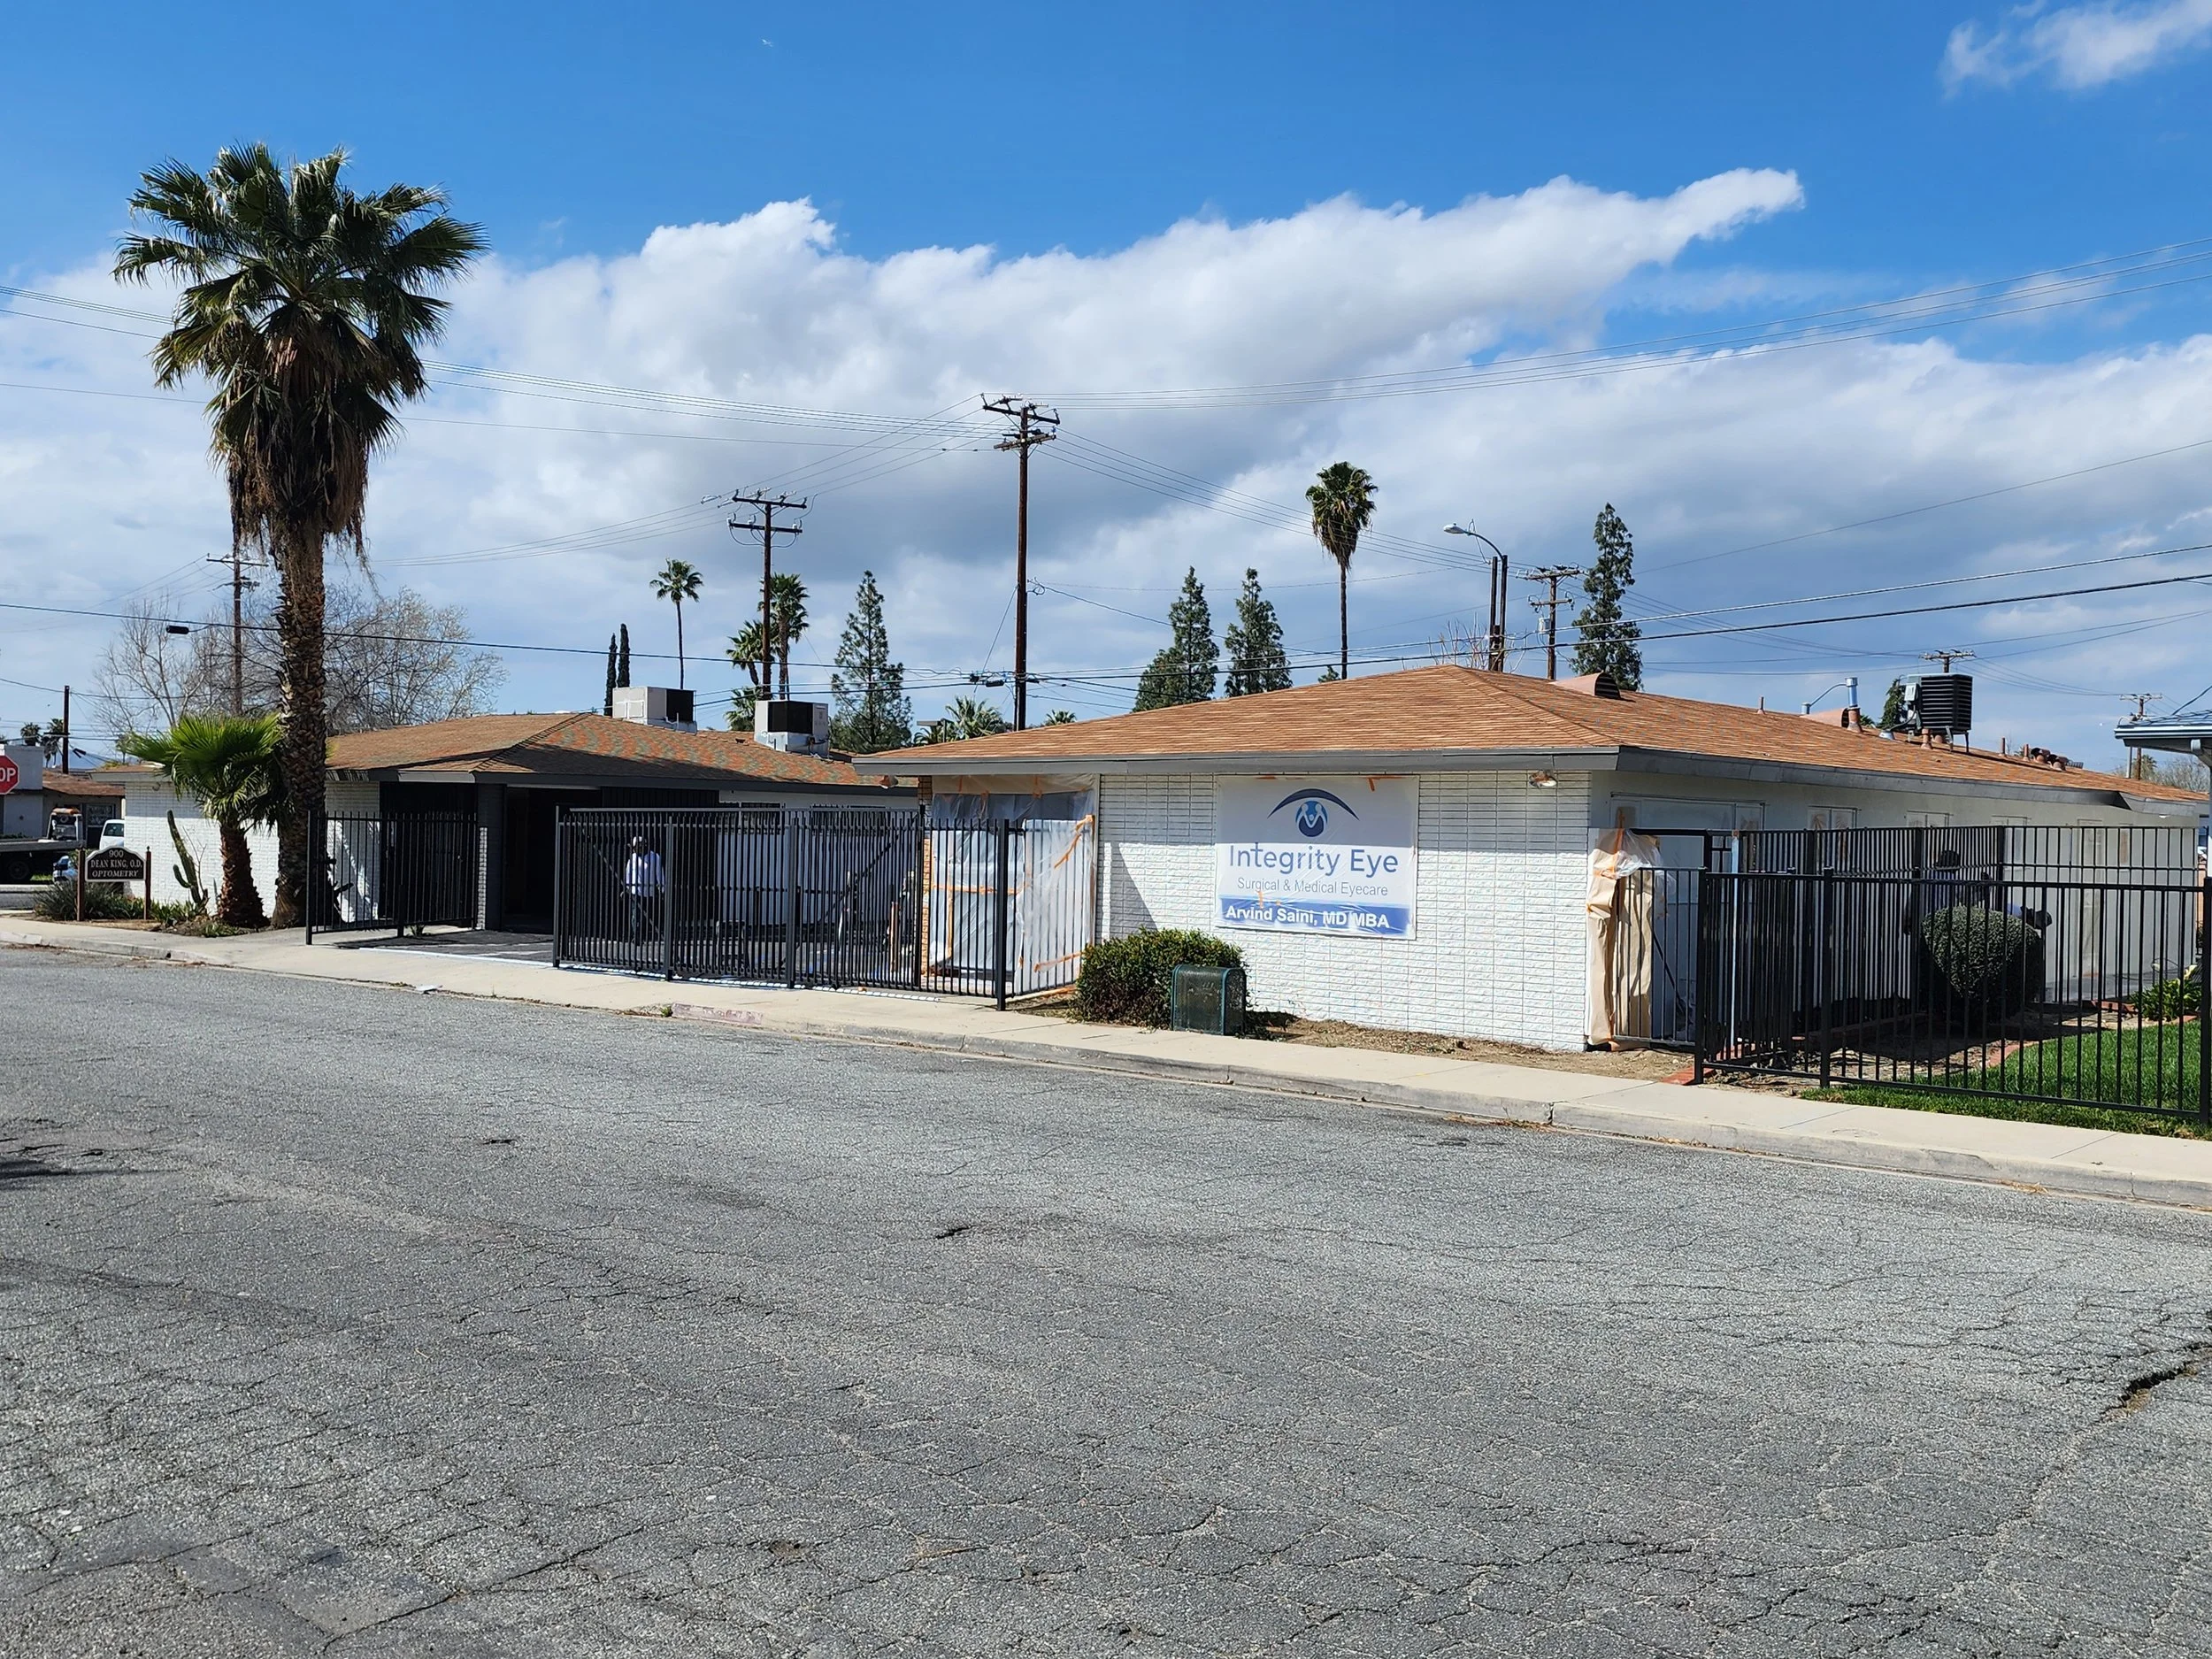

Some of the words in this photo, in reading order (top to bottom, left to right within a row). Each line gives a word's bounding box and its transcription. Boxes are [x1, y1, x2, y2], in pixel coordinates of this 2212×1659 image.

[90, 859, 109, 868] DEAN
[110, 859, 128, 869] KING,
[1230, 842, 1340, 876] Integrity
[1350, 849, 1398, 878] Eye
[1237, 877, 1279, 892] Surgical
[1283, 879, 1291, 891] &
[1294, 880, 1337, 894] Medical
[1340, 882, 1388, 897] Eyecare
[1225, 905, 1272, 921] Arvind
[1277, 908, 1317, 926] Saini,
[1352, 912, 1390, 928] MBA
